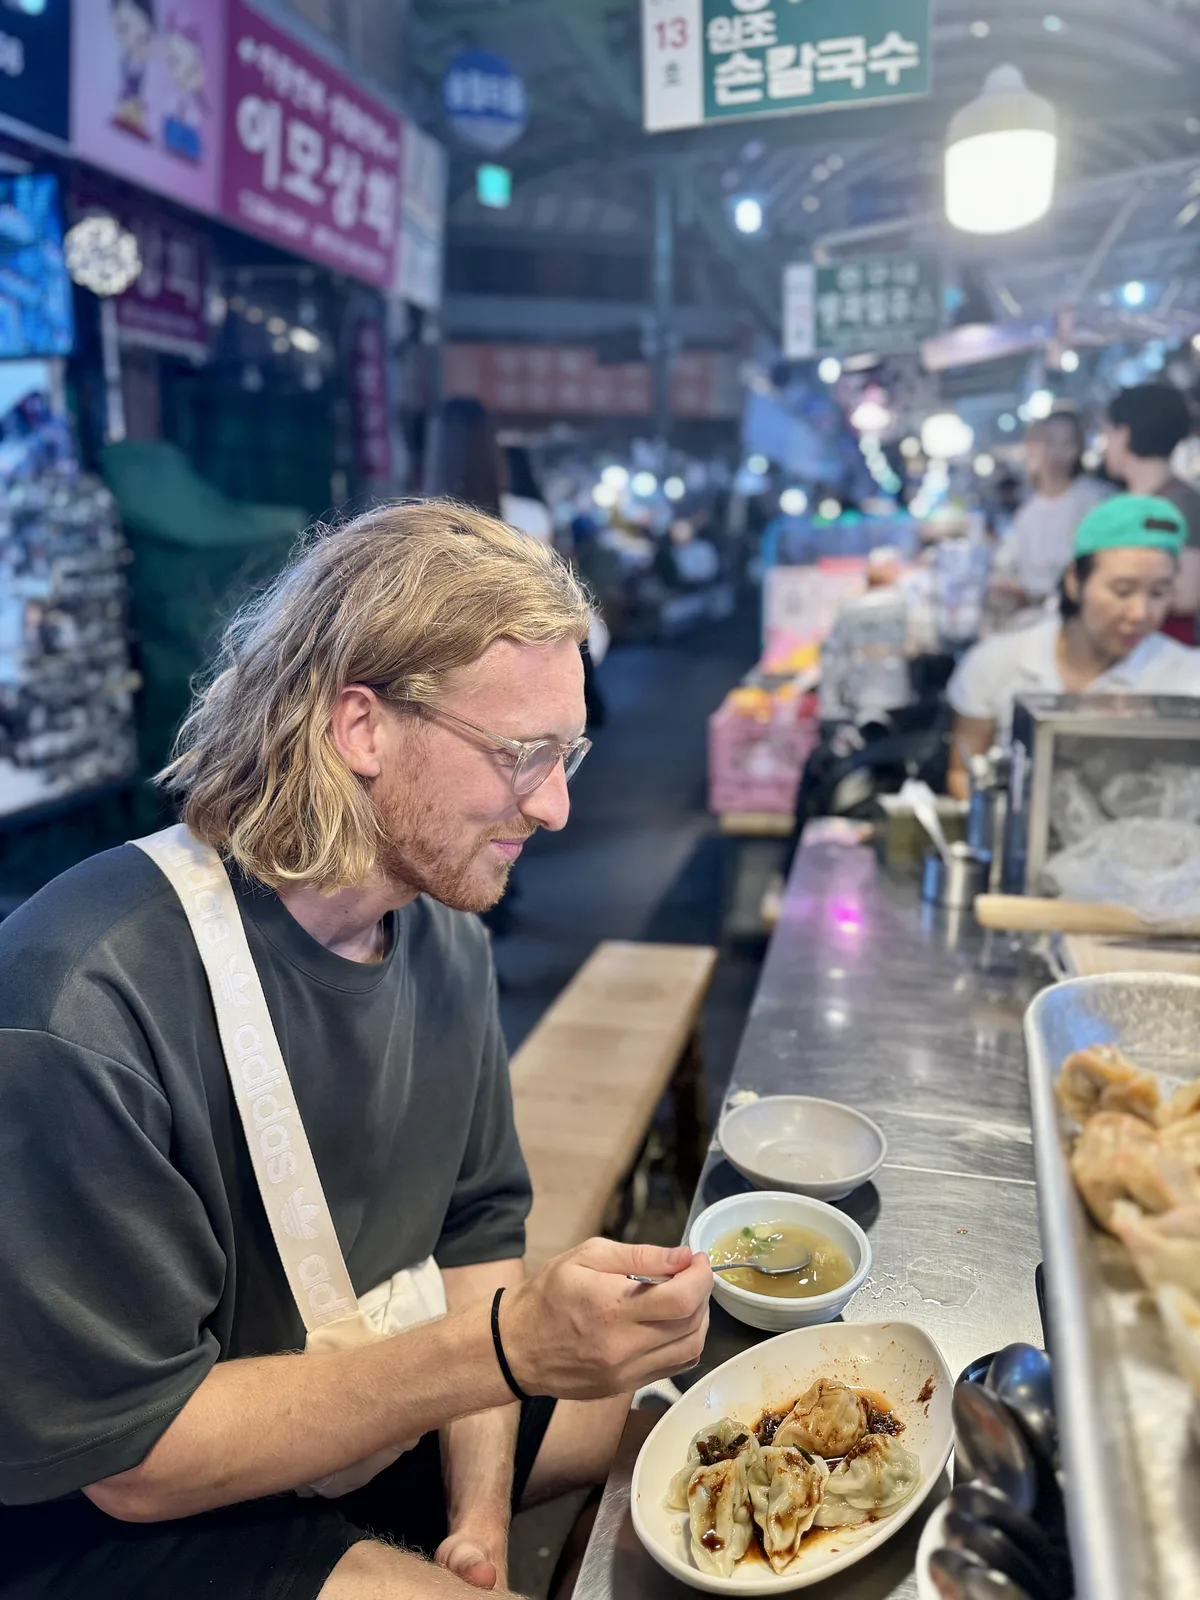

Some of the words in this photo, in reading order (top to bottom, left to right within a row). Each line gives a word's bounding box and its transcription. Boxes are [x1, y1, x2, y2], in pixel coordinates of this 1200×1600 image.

[654, 17, 689, 50] 13
[707, 10, 777, 54] 원조
[713, 31, 920, 106] 손칼국수
[236, 94, 398, 248] 이모상회
[234, 1024, 297, 1184] adidas
